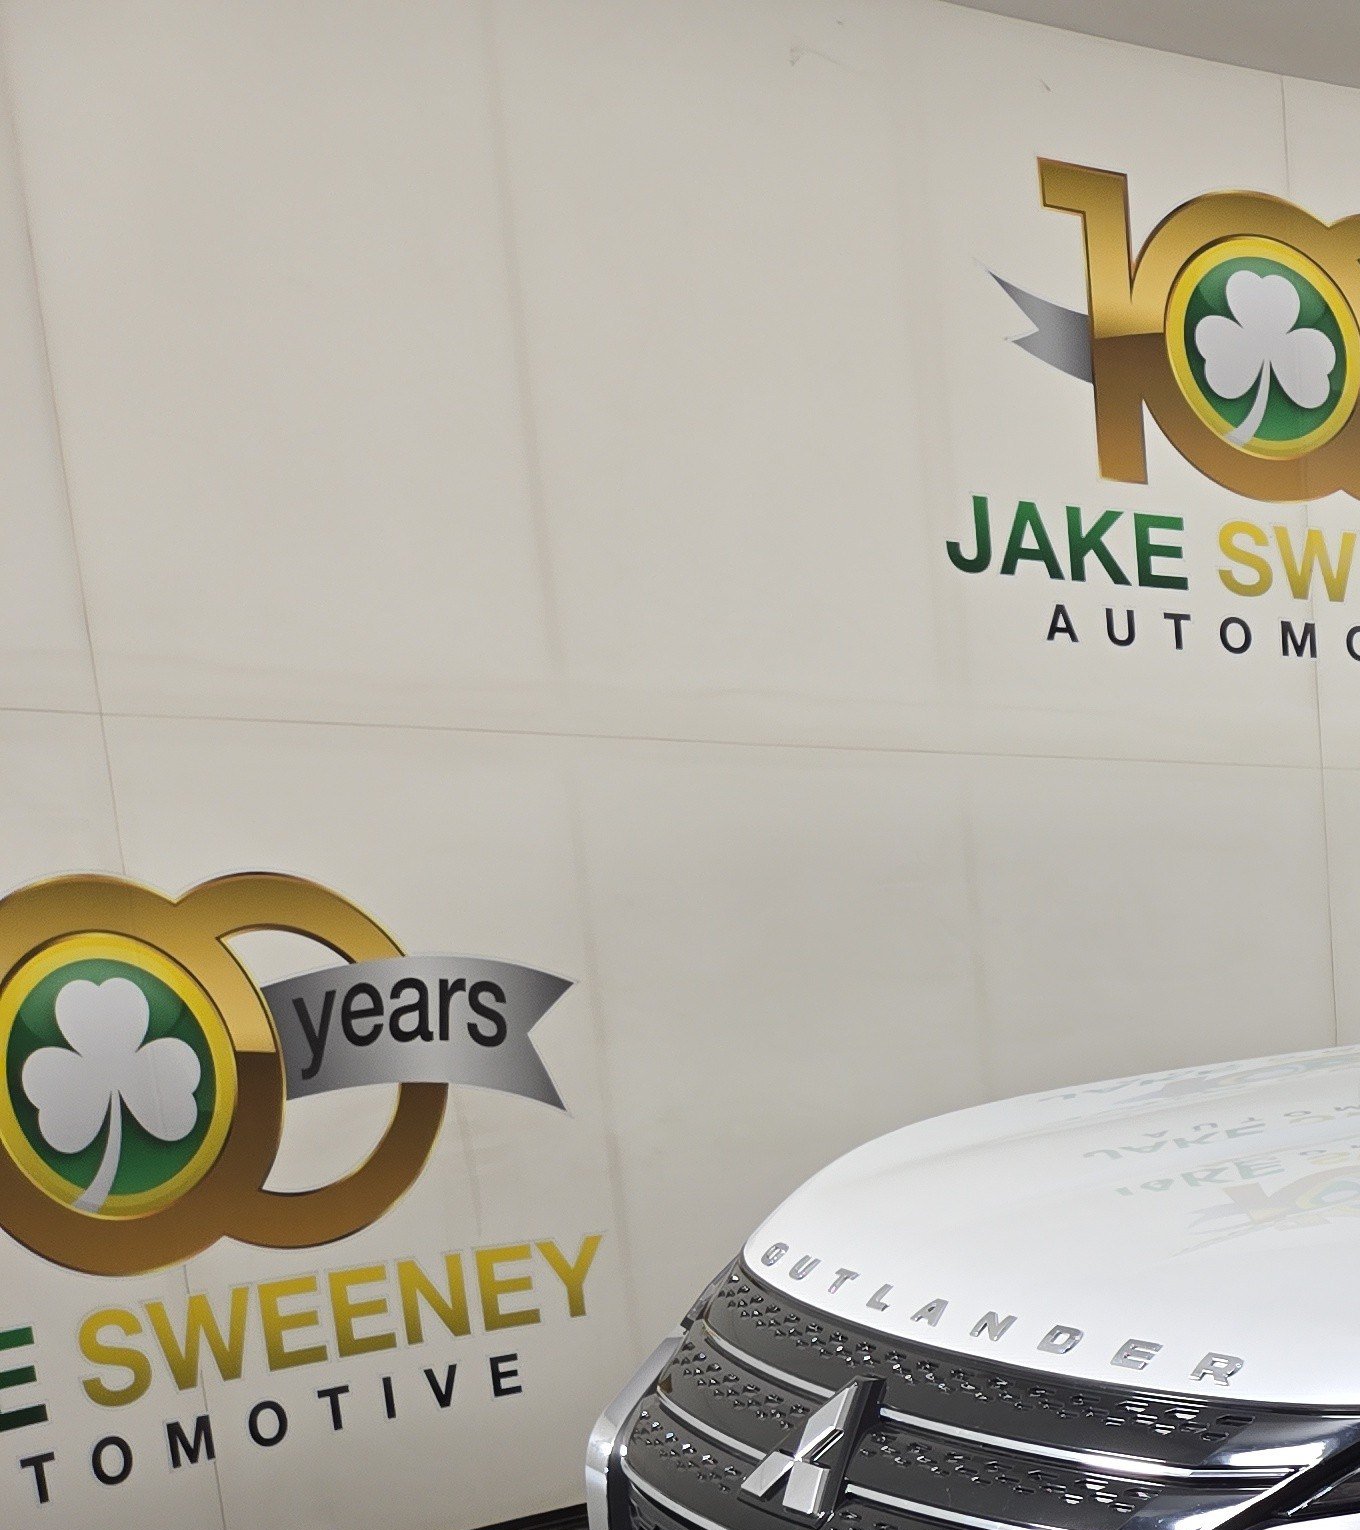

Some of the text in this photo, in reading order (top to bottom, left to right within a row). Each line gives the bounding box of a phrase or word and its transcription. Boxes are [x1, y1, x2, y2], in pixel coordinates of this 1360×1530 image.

[945, 494, 1190, 591] JAKE
[292, 976, 508, 1080] years
[78, 1234, 604, 1408] SWEENEY
[760, 1242, 1246, 1387] OUTLANDER
